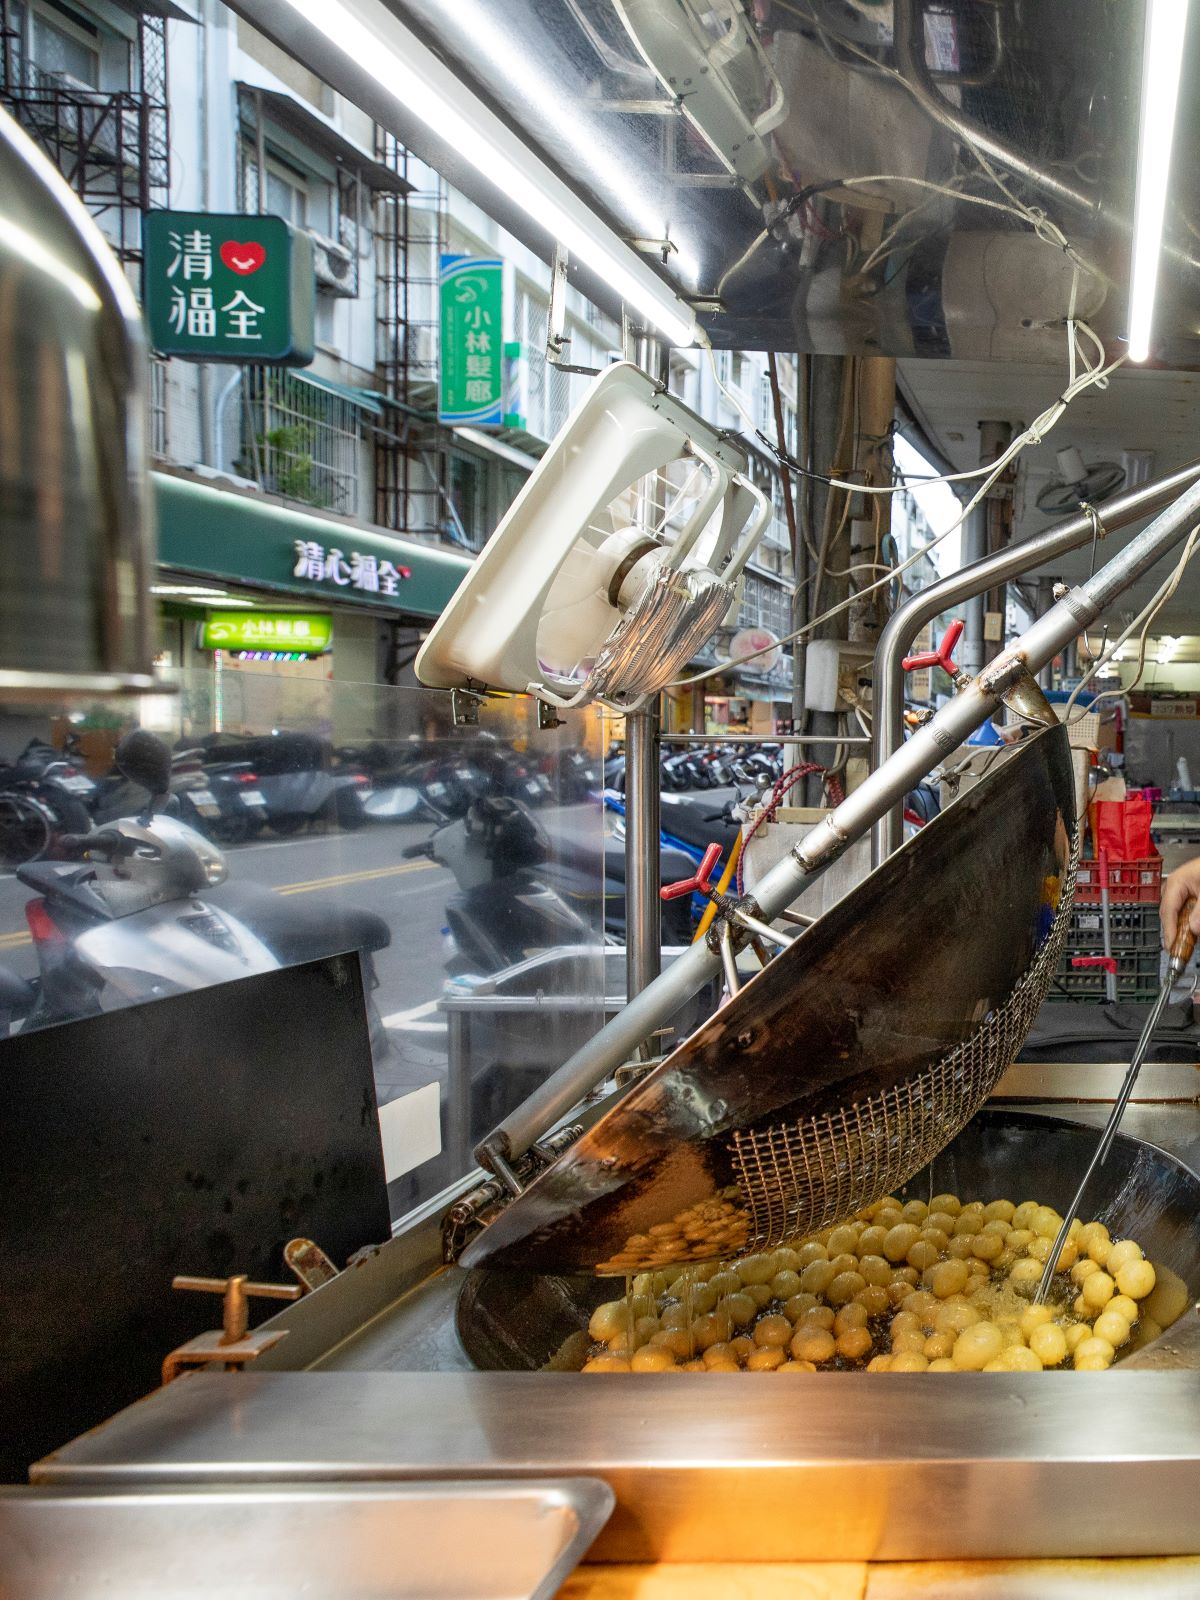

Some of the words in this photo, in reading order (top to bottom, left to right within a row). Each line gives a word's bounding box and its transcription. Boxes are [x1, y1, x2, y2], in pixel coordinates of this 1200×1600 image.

[168, 285, 266, 340] 福全
[463, 305, 493, 403] 小林髮廊
[293, 540, 402, 597] 清心福全
